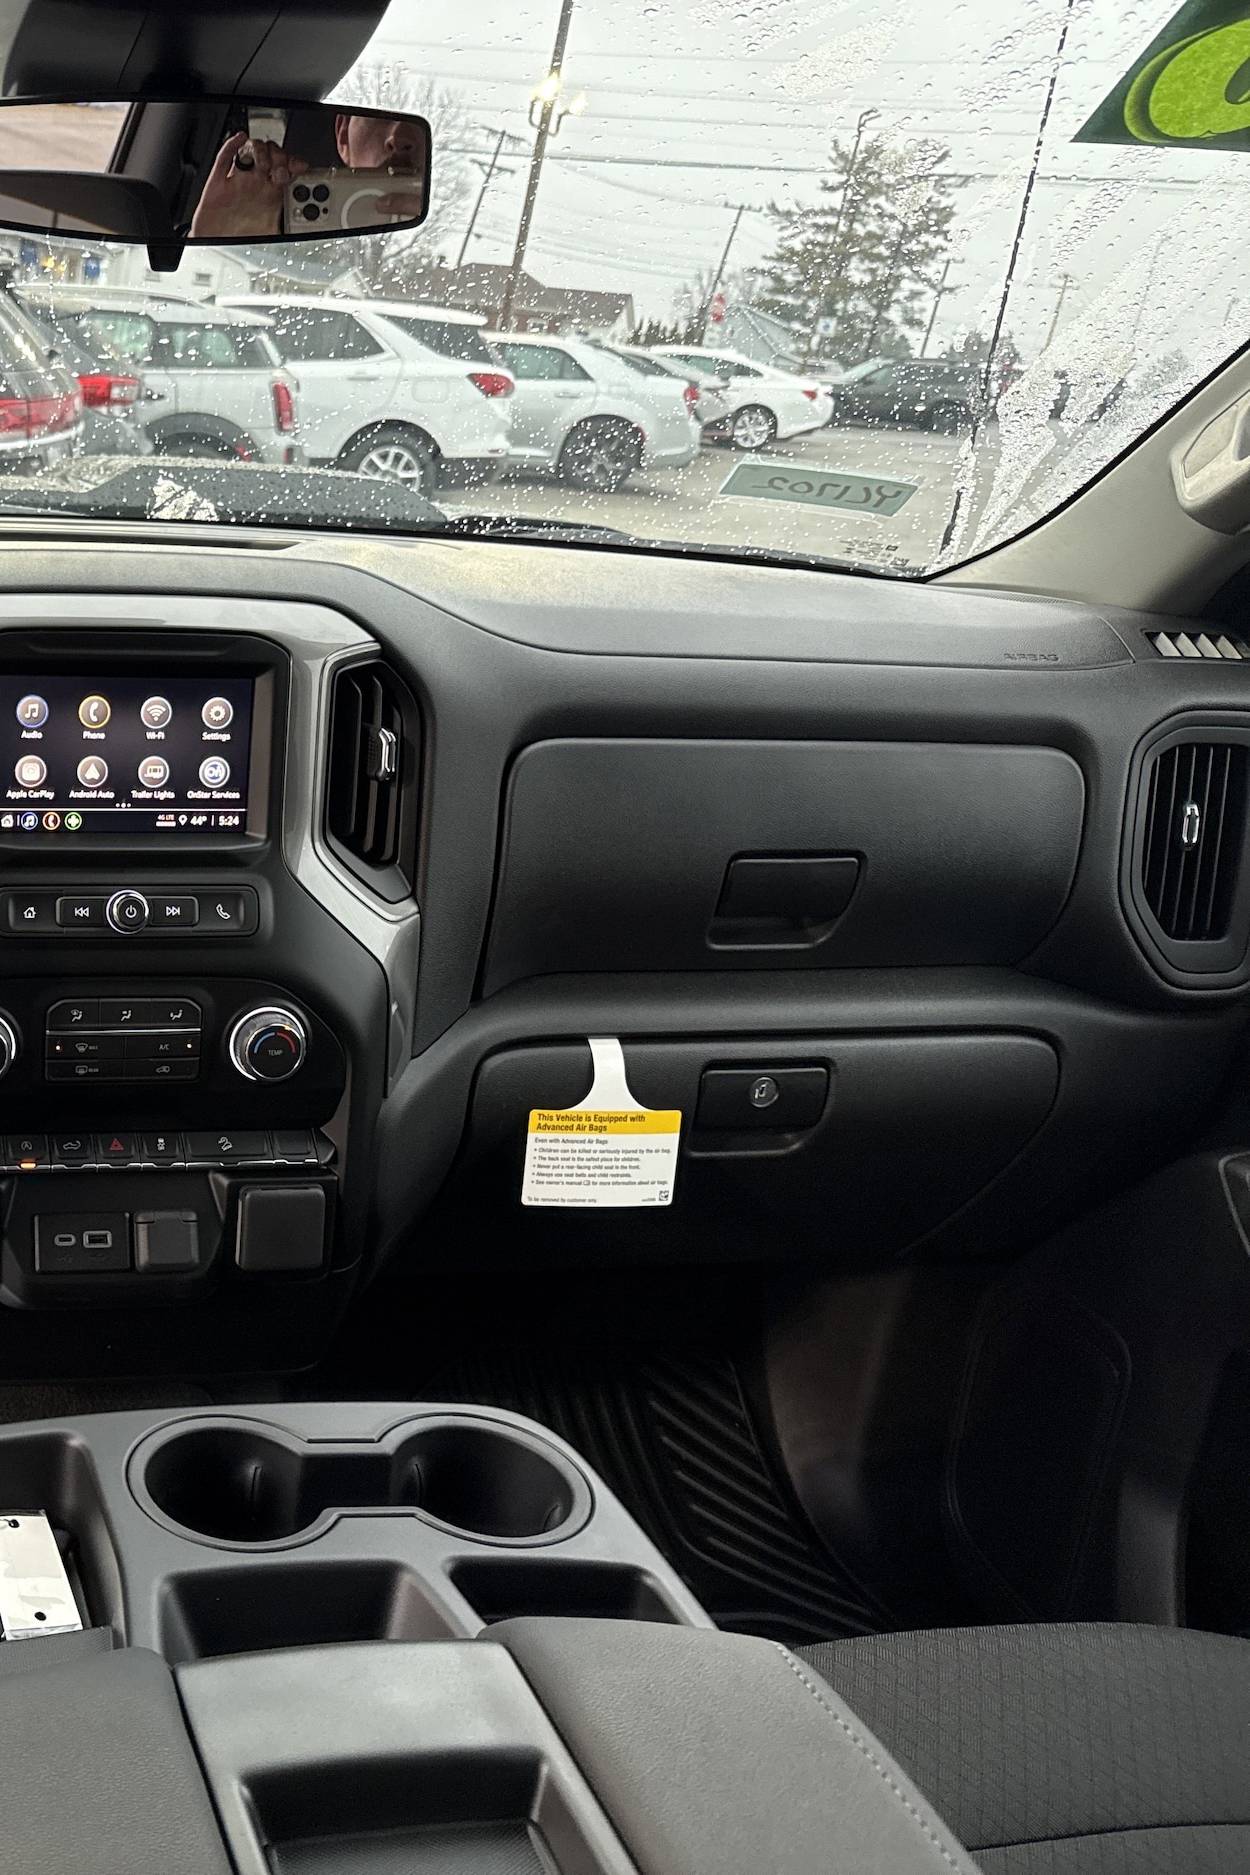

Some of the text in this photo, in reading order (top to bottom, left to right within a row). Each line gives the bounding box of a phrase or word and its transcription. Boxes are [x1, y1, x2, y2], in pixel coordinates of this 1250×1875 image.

[20, 730, 43, 740] Audio
[82, 730, 106, 740] Phone
[202, 731, 231, 742] Settings
[6, 790, 55, 800] Apple CarPlay
[69, 790, 115, 799] Android Auto
[131, 790, 176, 801] Trailer Lights
[186, 790, 241, 799] OnStar Services
[218, 815, 240, 826] 5:24
[538, 1113, 646, 1124] This Vehicle is Equipped with
[536, 1122, 607, 1133] Advanced Air Bags
